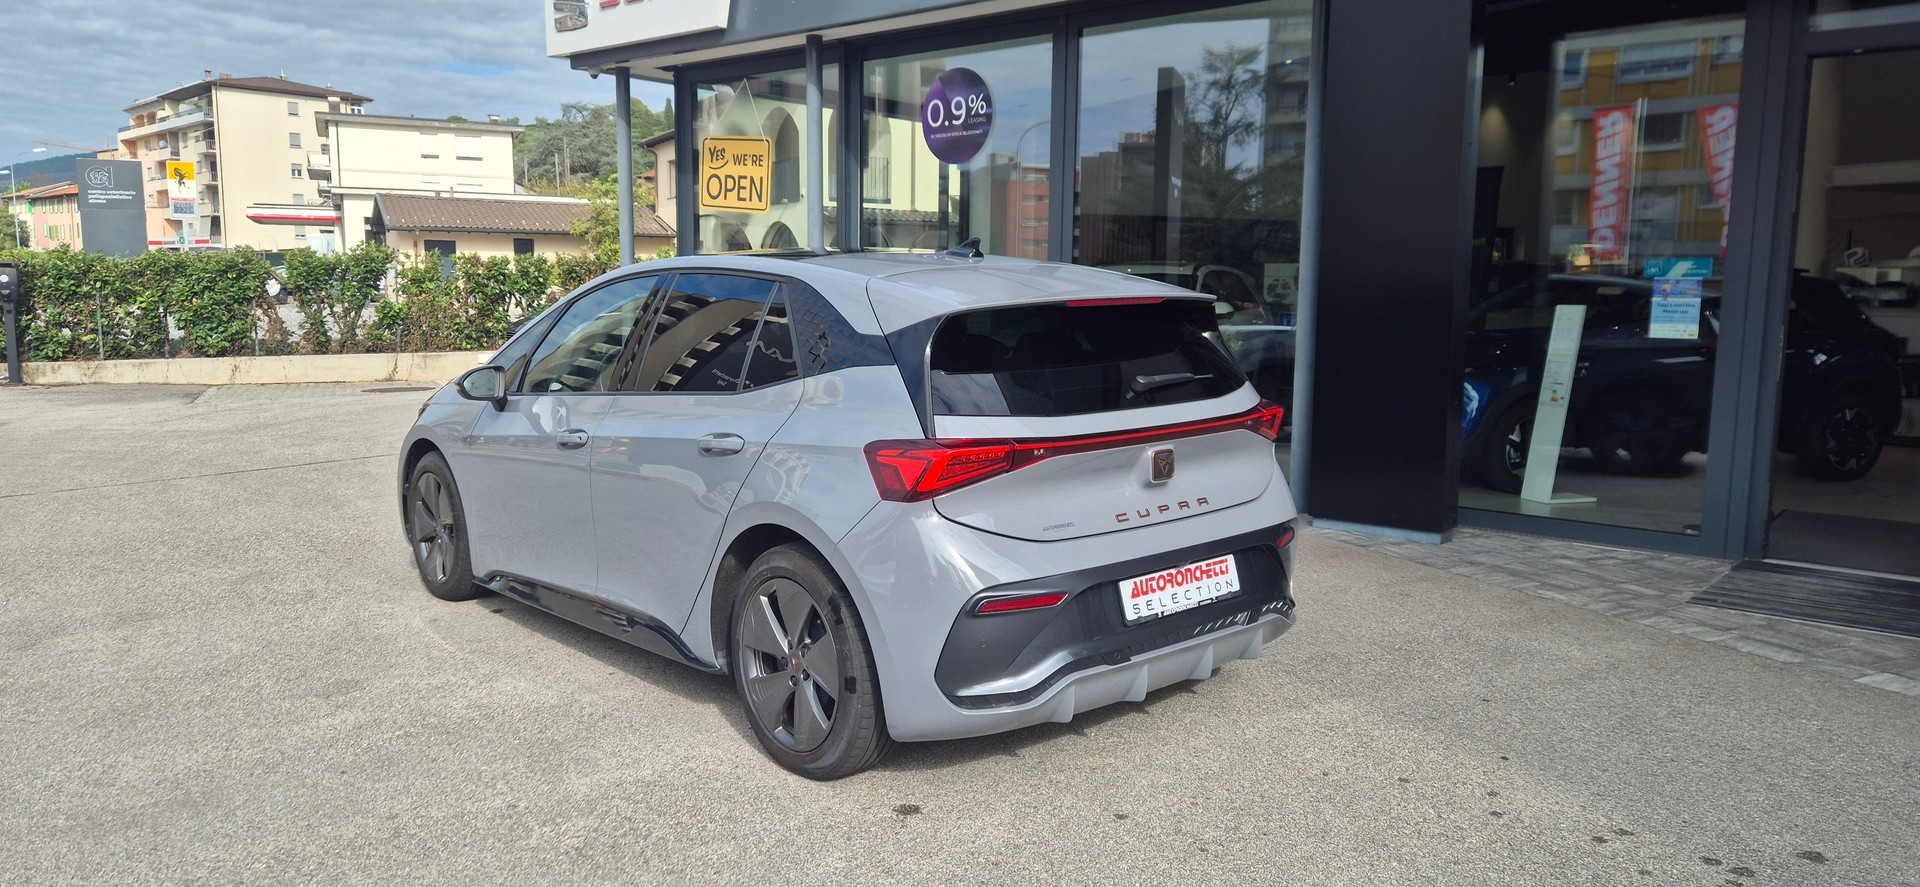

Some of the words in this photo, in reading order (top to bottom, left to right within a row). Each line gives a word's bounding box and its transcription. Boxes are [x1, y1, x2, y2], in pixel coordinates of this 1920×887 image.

[927, 93, 987, 128] 0.9%
[967, 116, 987, 124] LEASING
[708, 145, 726, 163] YES
[732, 153, 764, 167] WE'RE
[706, 173, 764, 203] OPEN
[1114, 496, 1210, 523] CUPRA
[1130, 558, 1229, 599] AUTORONCHETTI
[1132, 578, 1234, 615] SELECTION
